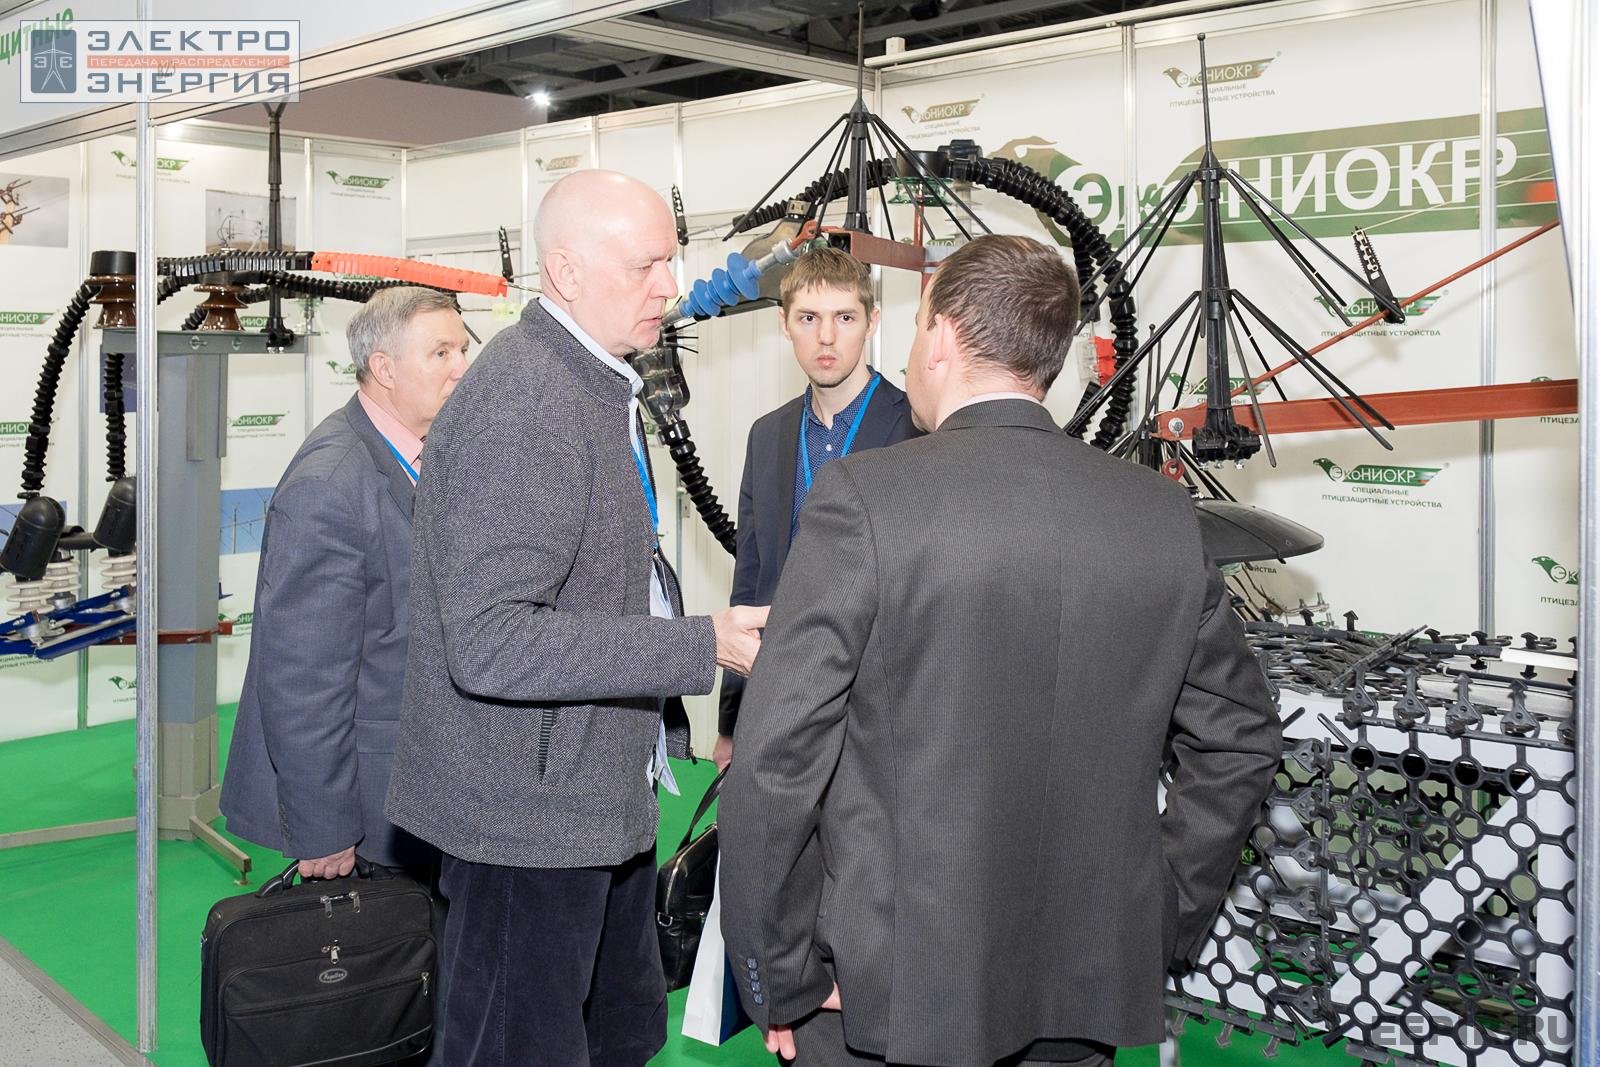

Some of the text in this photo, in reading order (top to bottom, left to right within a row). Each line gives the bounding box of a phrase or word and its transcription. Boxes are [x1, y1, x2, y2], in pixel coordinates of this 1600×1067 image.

[1390, 329, 1440, 337] УСТРОЙСТВА
[1331, 466, 1416, 483] ЭкоНИОКР
[1352, 486, 1408, 495] СПЕЦИАЛЬНЫЕ
[1322, 494, 1442, 508] ПТИЦЕЗАЩИТНЫЕ УСТРОЙСТВА
